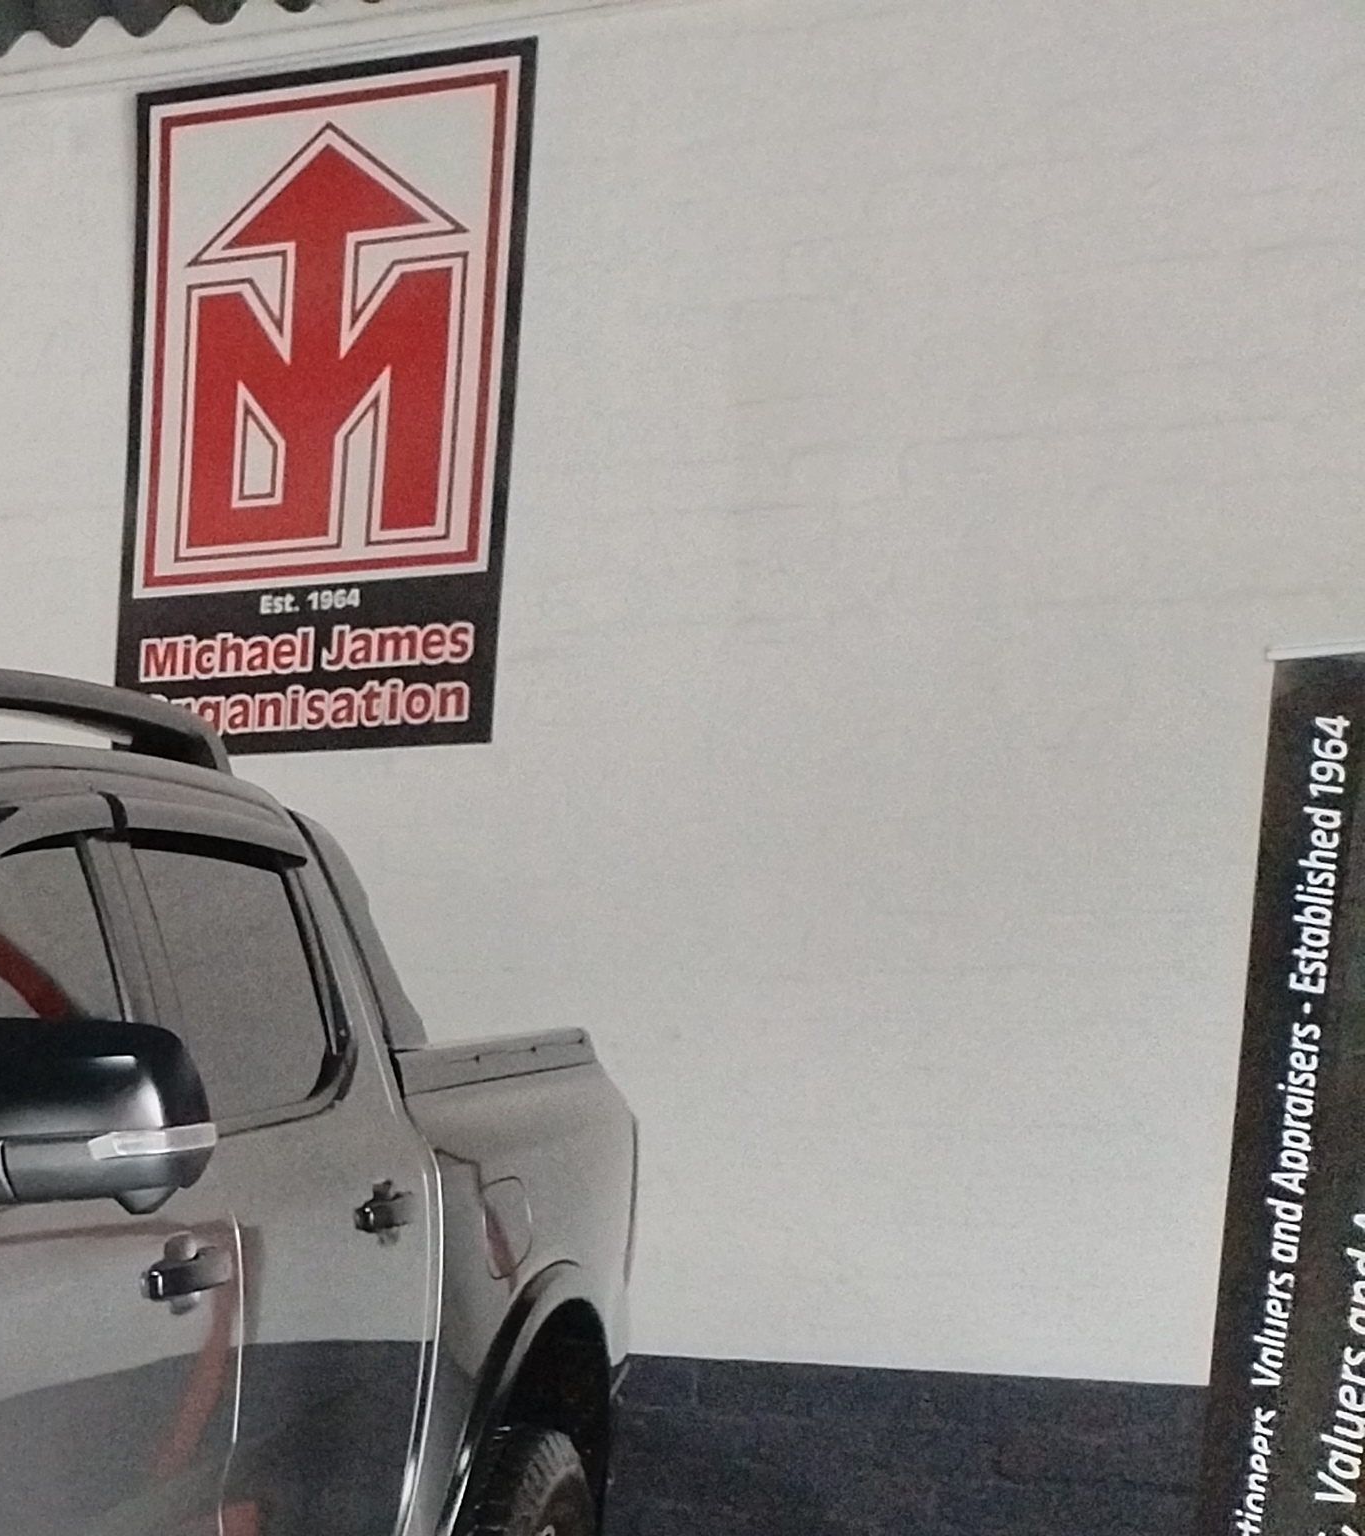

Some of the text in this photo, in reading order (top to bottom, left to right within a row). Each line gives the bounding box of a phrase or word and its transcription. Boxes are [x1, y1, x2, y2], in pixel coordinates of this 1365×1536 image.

[260, 588, 361, 615] Est. 1964
[139, 621, 475, 683] Michael James
[149, 678, 470, 736] ganisation
[1308, 715, 1351, 797] 1964
[1288, 805, 1342, 995] Established
[1271, 1021, 1321, 1195] Appraisers
[1266, 1197, 1303, 1264] and
